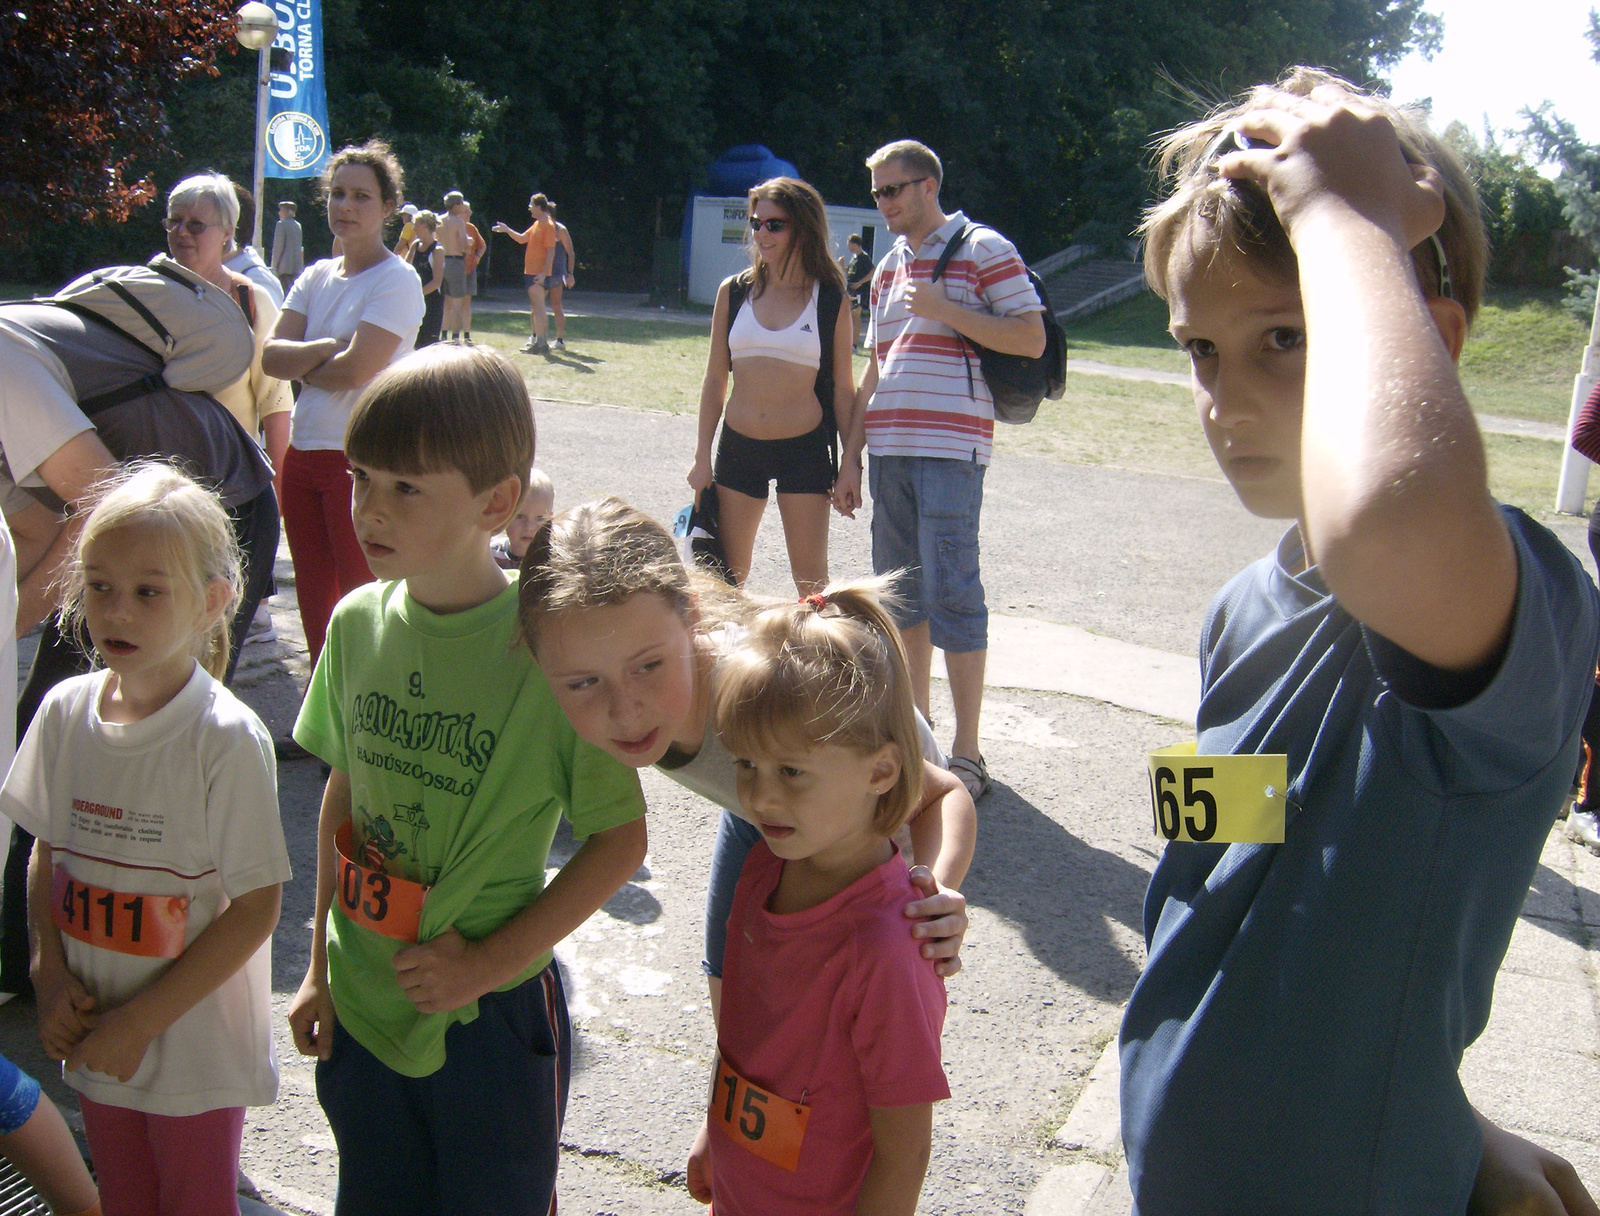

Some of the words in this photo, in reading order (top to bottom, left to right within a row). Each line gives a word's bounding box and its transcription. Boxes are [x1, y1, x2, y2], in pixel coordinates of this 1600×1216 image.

[297, 23, 314, 82] TORNA
[408, 671, 426, 700] 9.
[138, 828, 162, 836] clothing
[1147, 766, 1218, 842] 65
[62, 880, 144, 942] 4111
